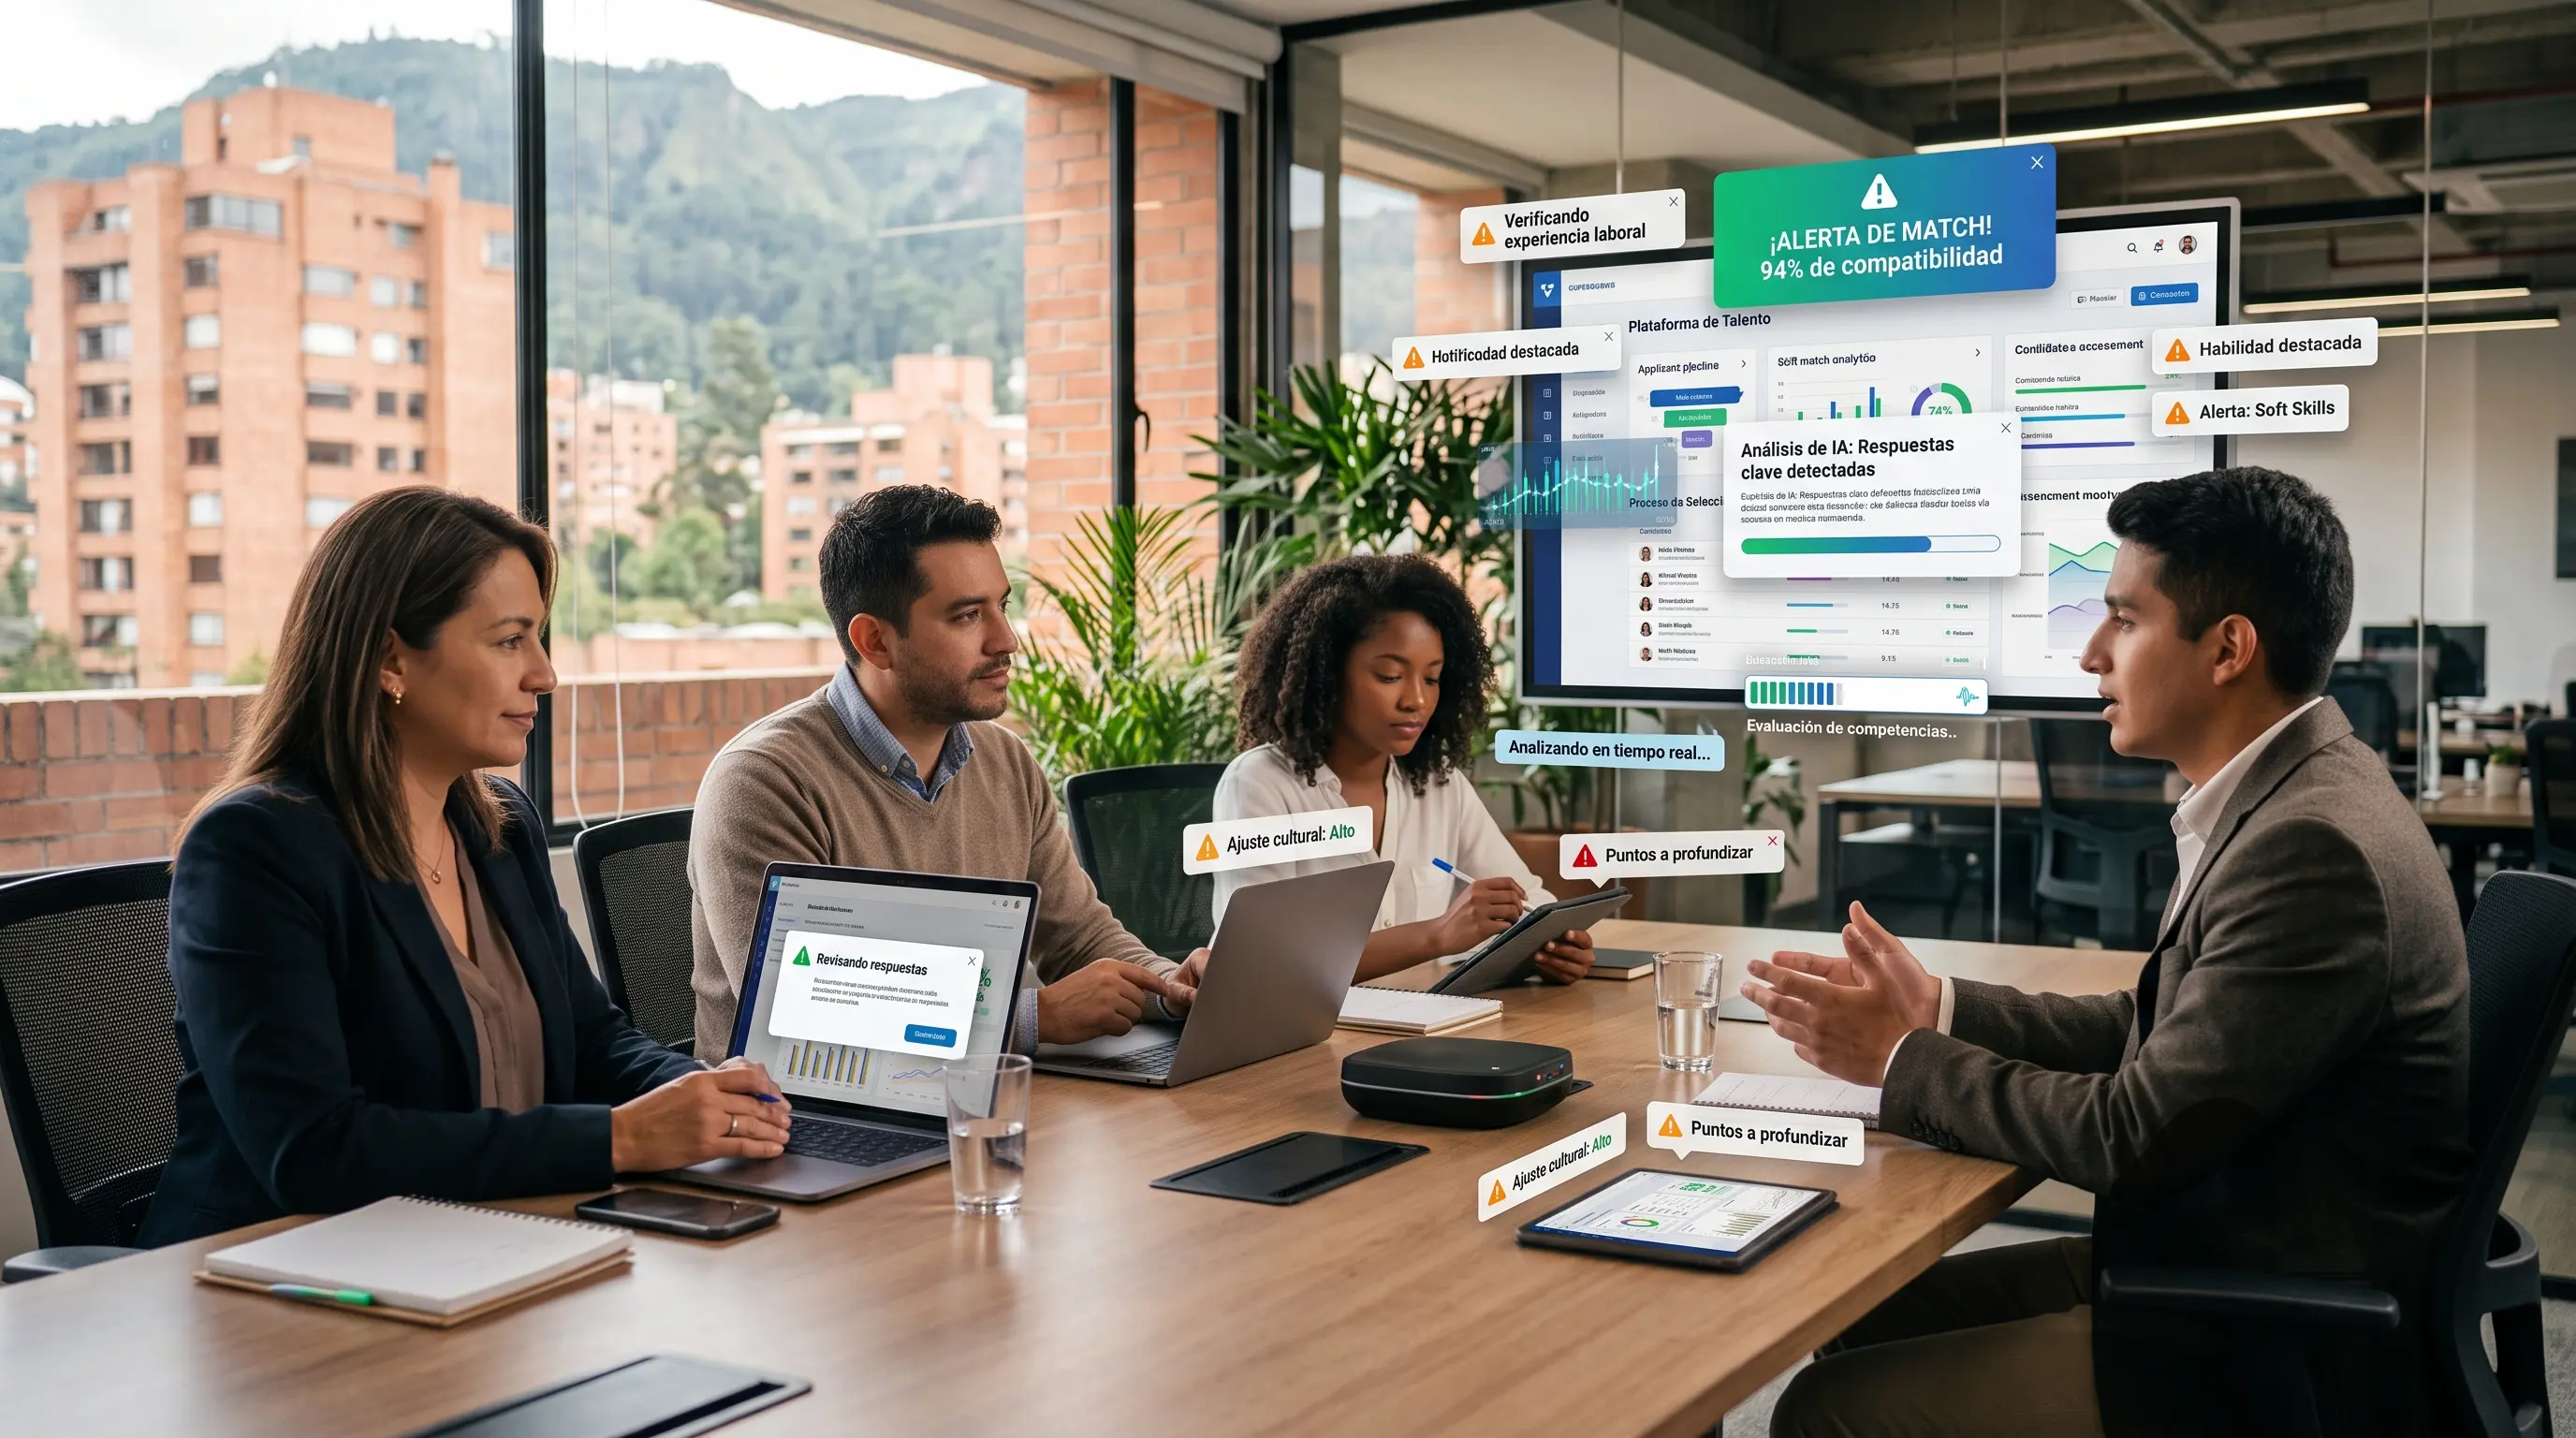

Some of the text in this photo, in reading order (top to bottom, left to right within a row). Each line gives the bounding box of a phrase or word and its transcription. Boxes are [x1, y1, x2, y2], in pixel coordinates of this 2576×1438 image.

[1629, 312, 1771, 334] Plataforma de Talento
[1800, 356, 1829, 365] match
[1928, 406, 1953, 415] 74%
[1630, 497, 1668, 507] Proceso
[1686, 496, 1723, 506] Selecci
[816, 953, 928, 976] Revisando respuestas
